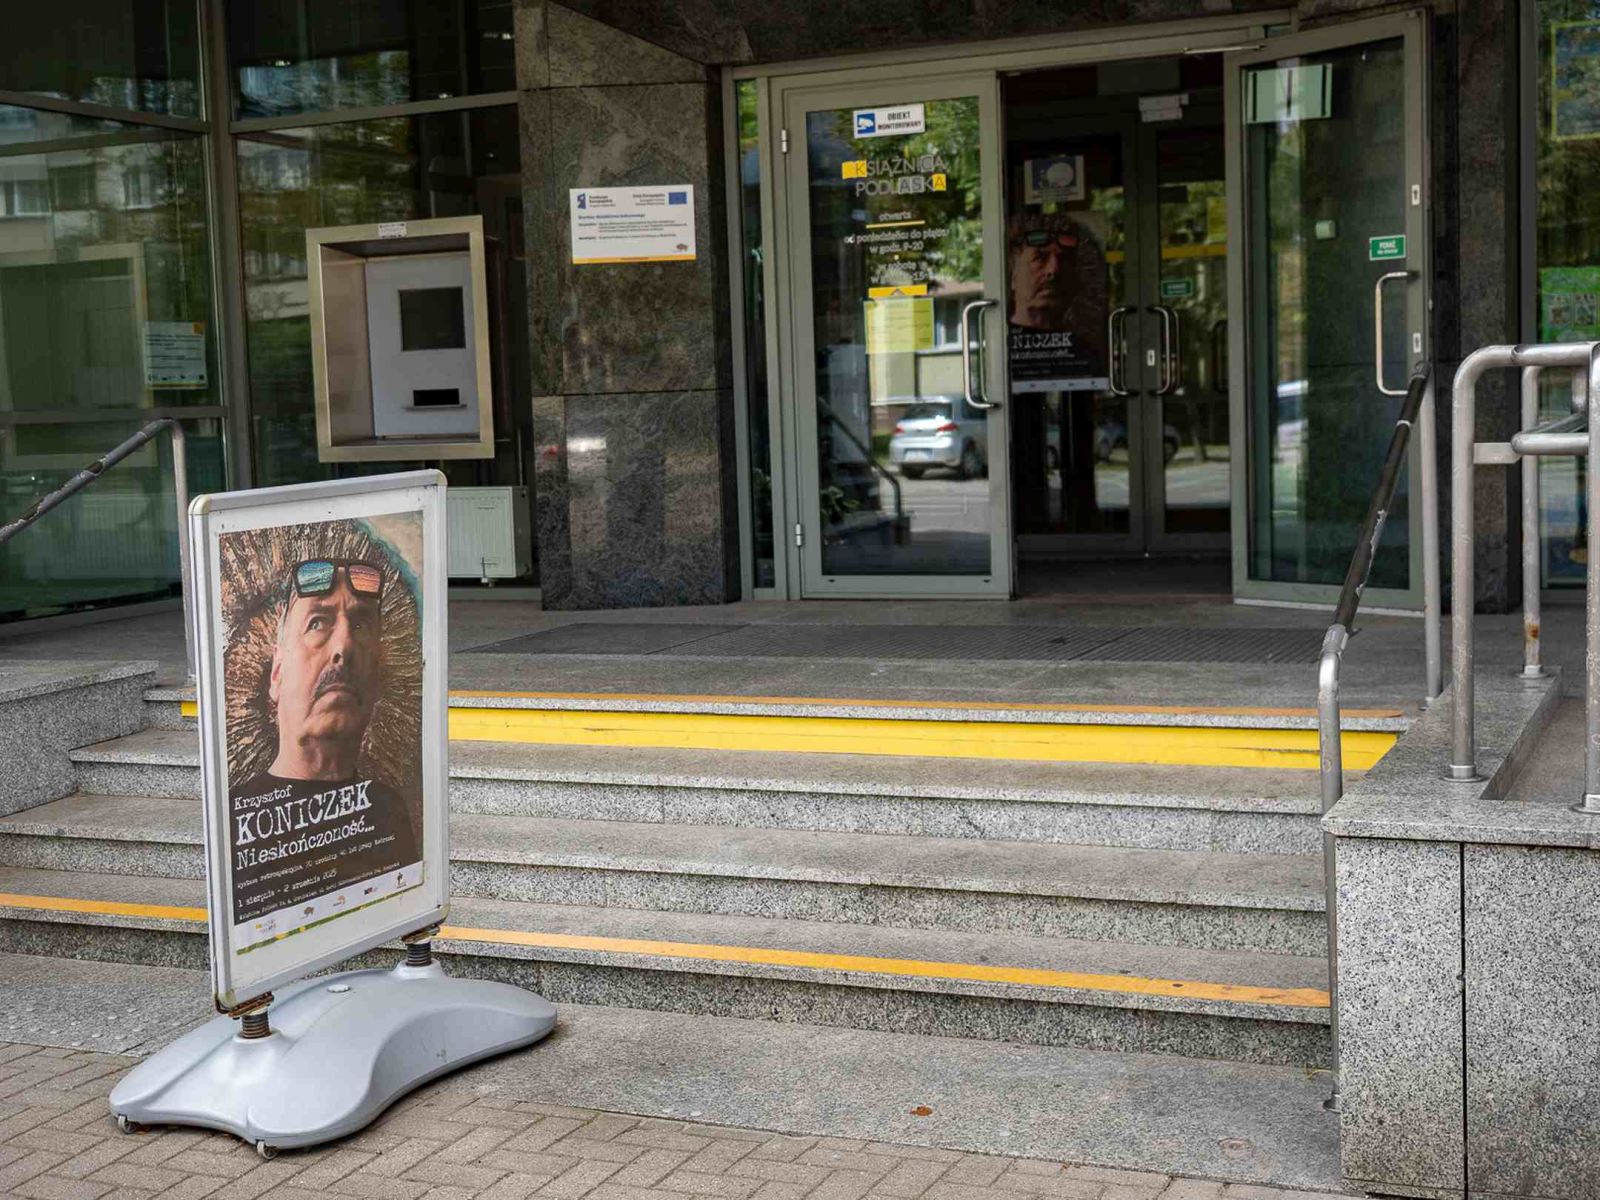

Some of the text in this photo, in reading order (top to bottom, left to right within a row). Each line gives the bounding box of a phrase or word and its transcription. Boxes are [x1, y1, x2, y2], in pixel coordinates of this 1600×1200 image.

[888, 111, 911, 121] OBIEKT
[856, 175, 945, 197] PODLASKA
[1012, 332, 1073, 349] NICZEK
[234, 784, 292, 811] Krzysztof
[235, 780, 372, 846] KONICZEK
[236, 815, 375, 871] Nieskończoność...
[283, 883, 290, 893] 2
